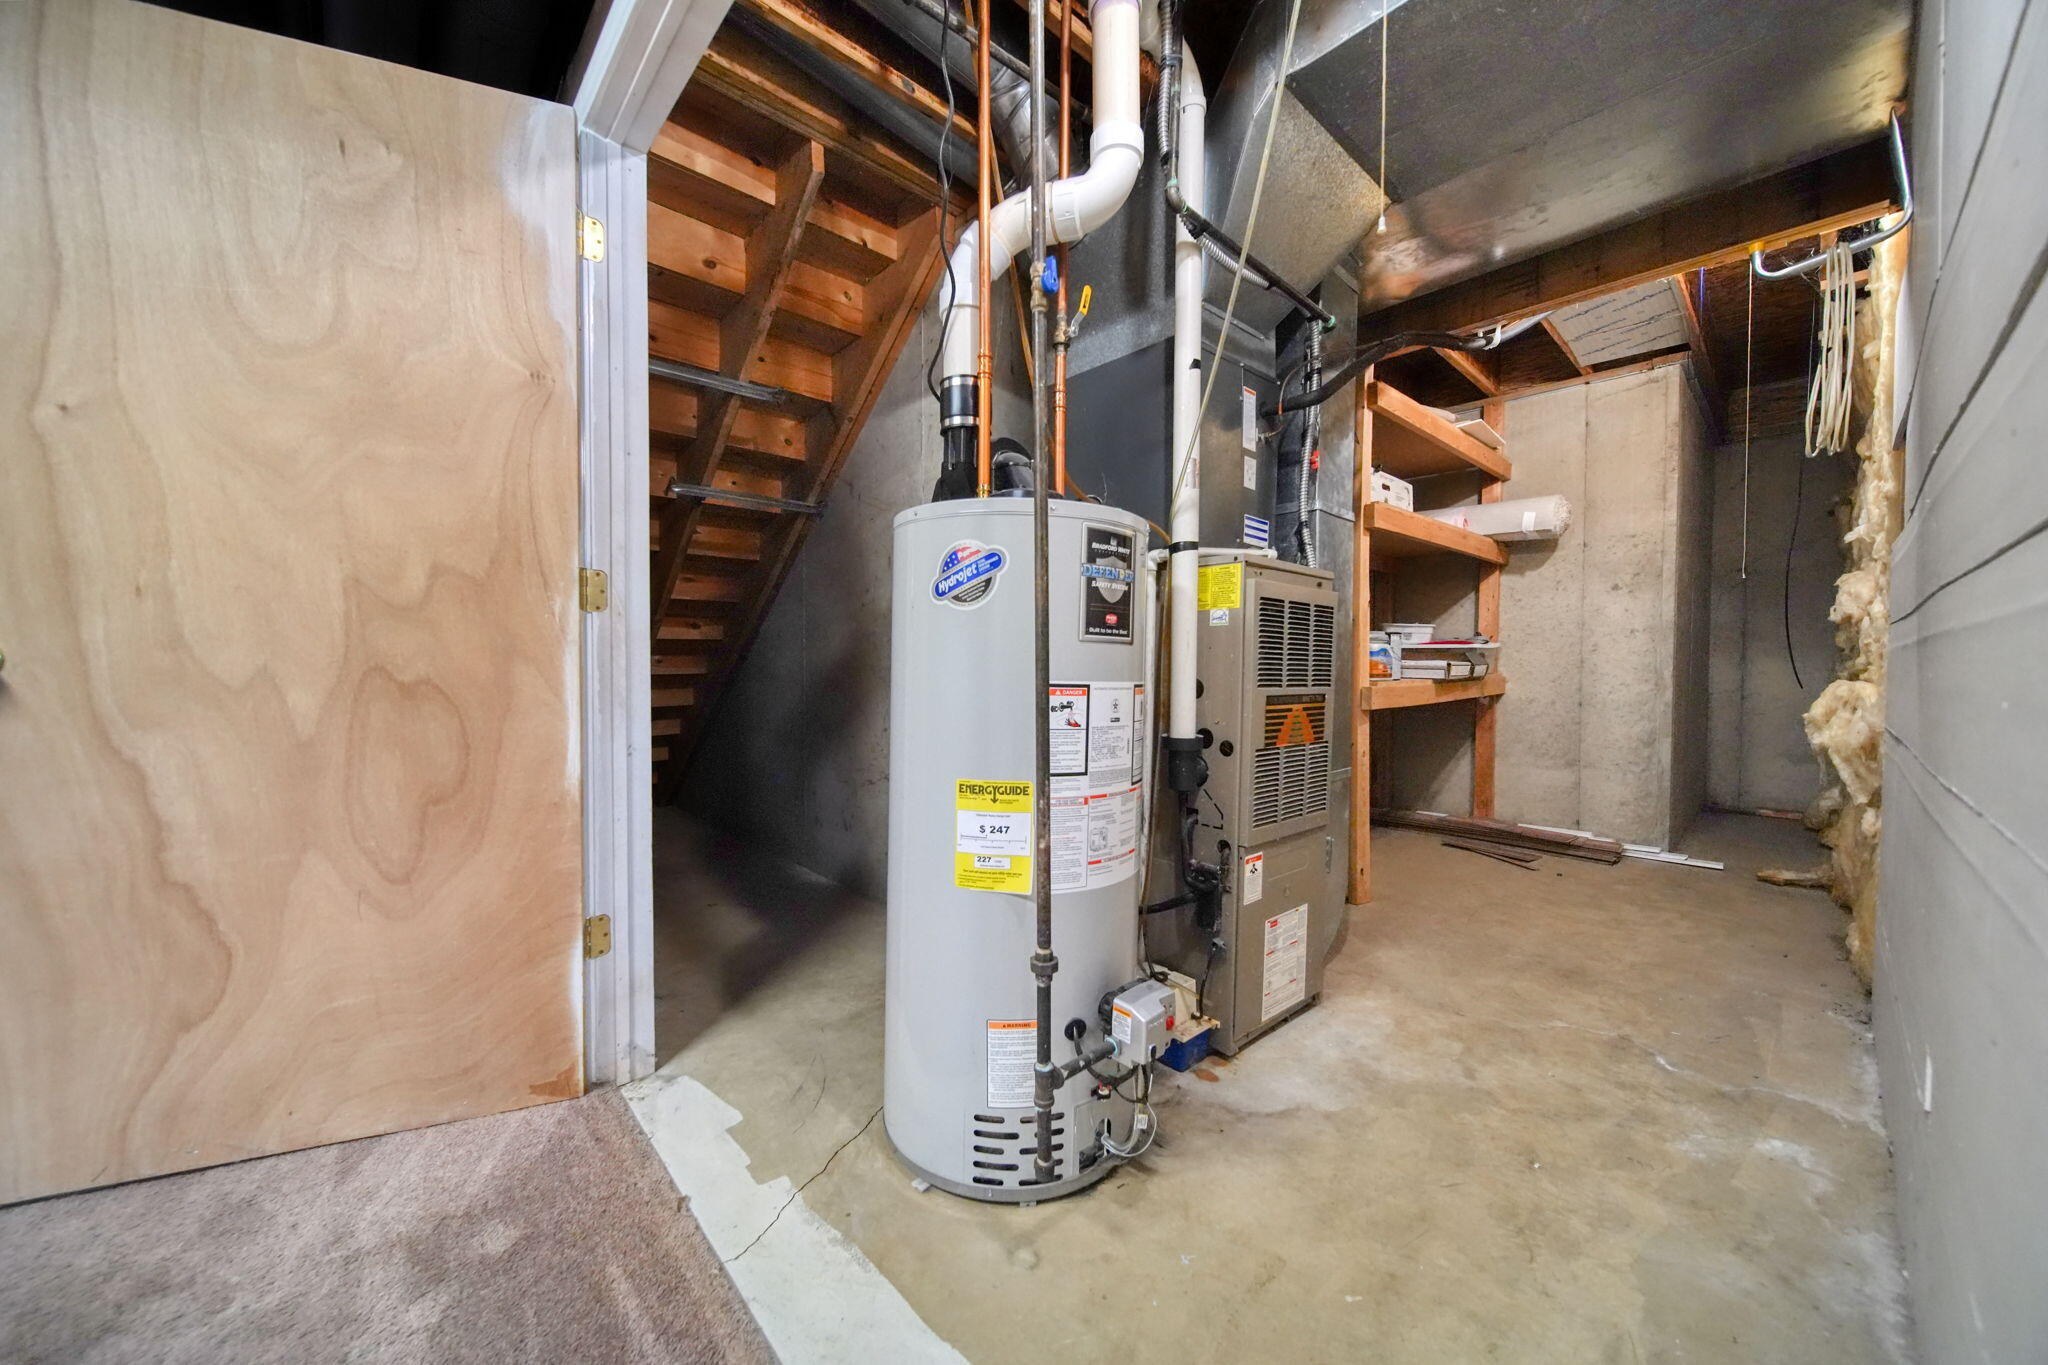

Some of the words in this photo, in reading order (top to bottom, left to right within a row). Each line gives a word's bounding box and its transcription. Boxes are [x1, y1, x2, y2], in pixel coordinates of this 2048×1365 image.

[938, 563, 978, 593] Hydrojet
[1082, 564, 1135, 582] DEFENDER
[959, 783, 1030, 797] ENERGYGUIDE
[979, 825, 986, 834] $
[990, 825, 1010, 834] 247
